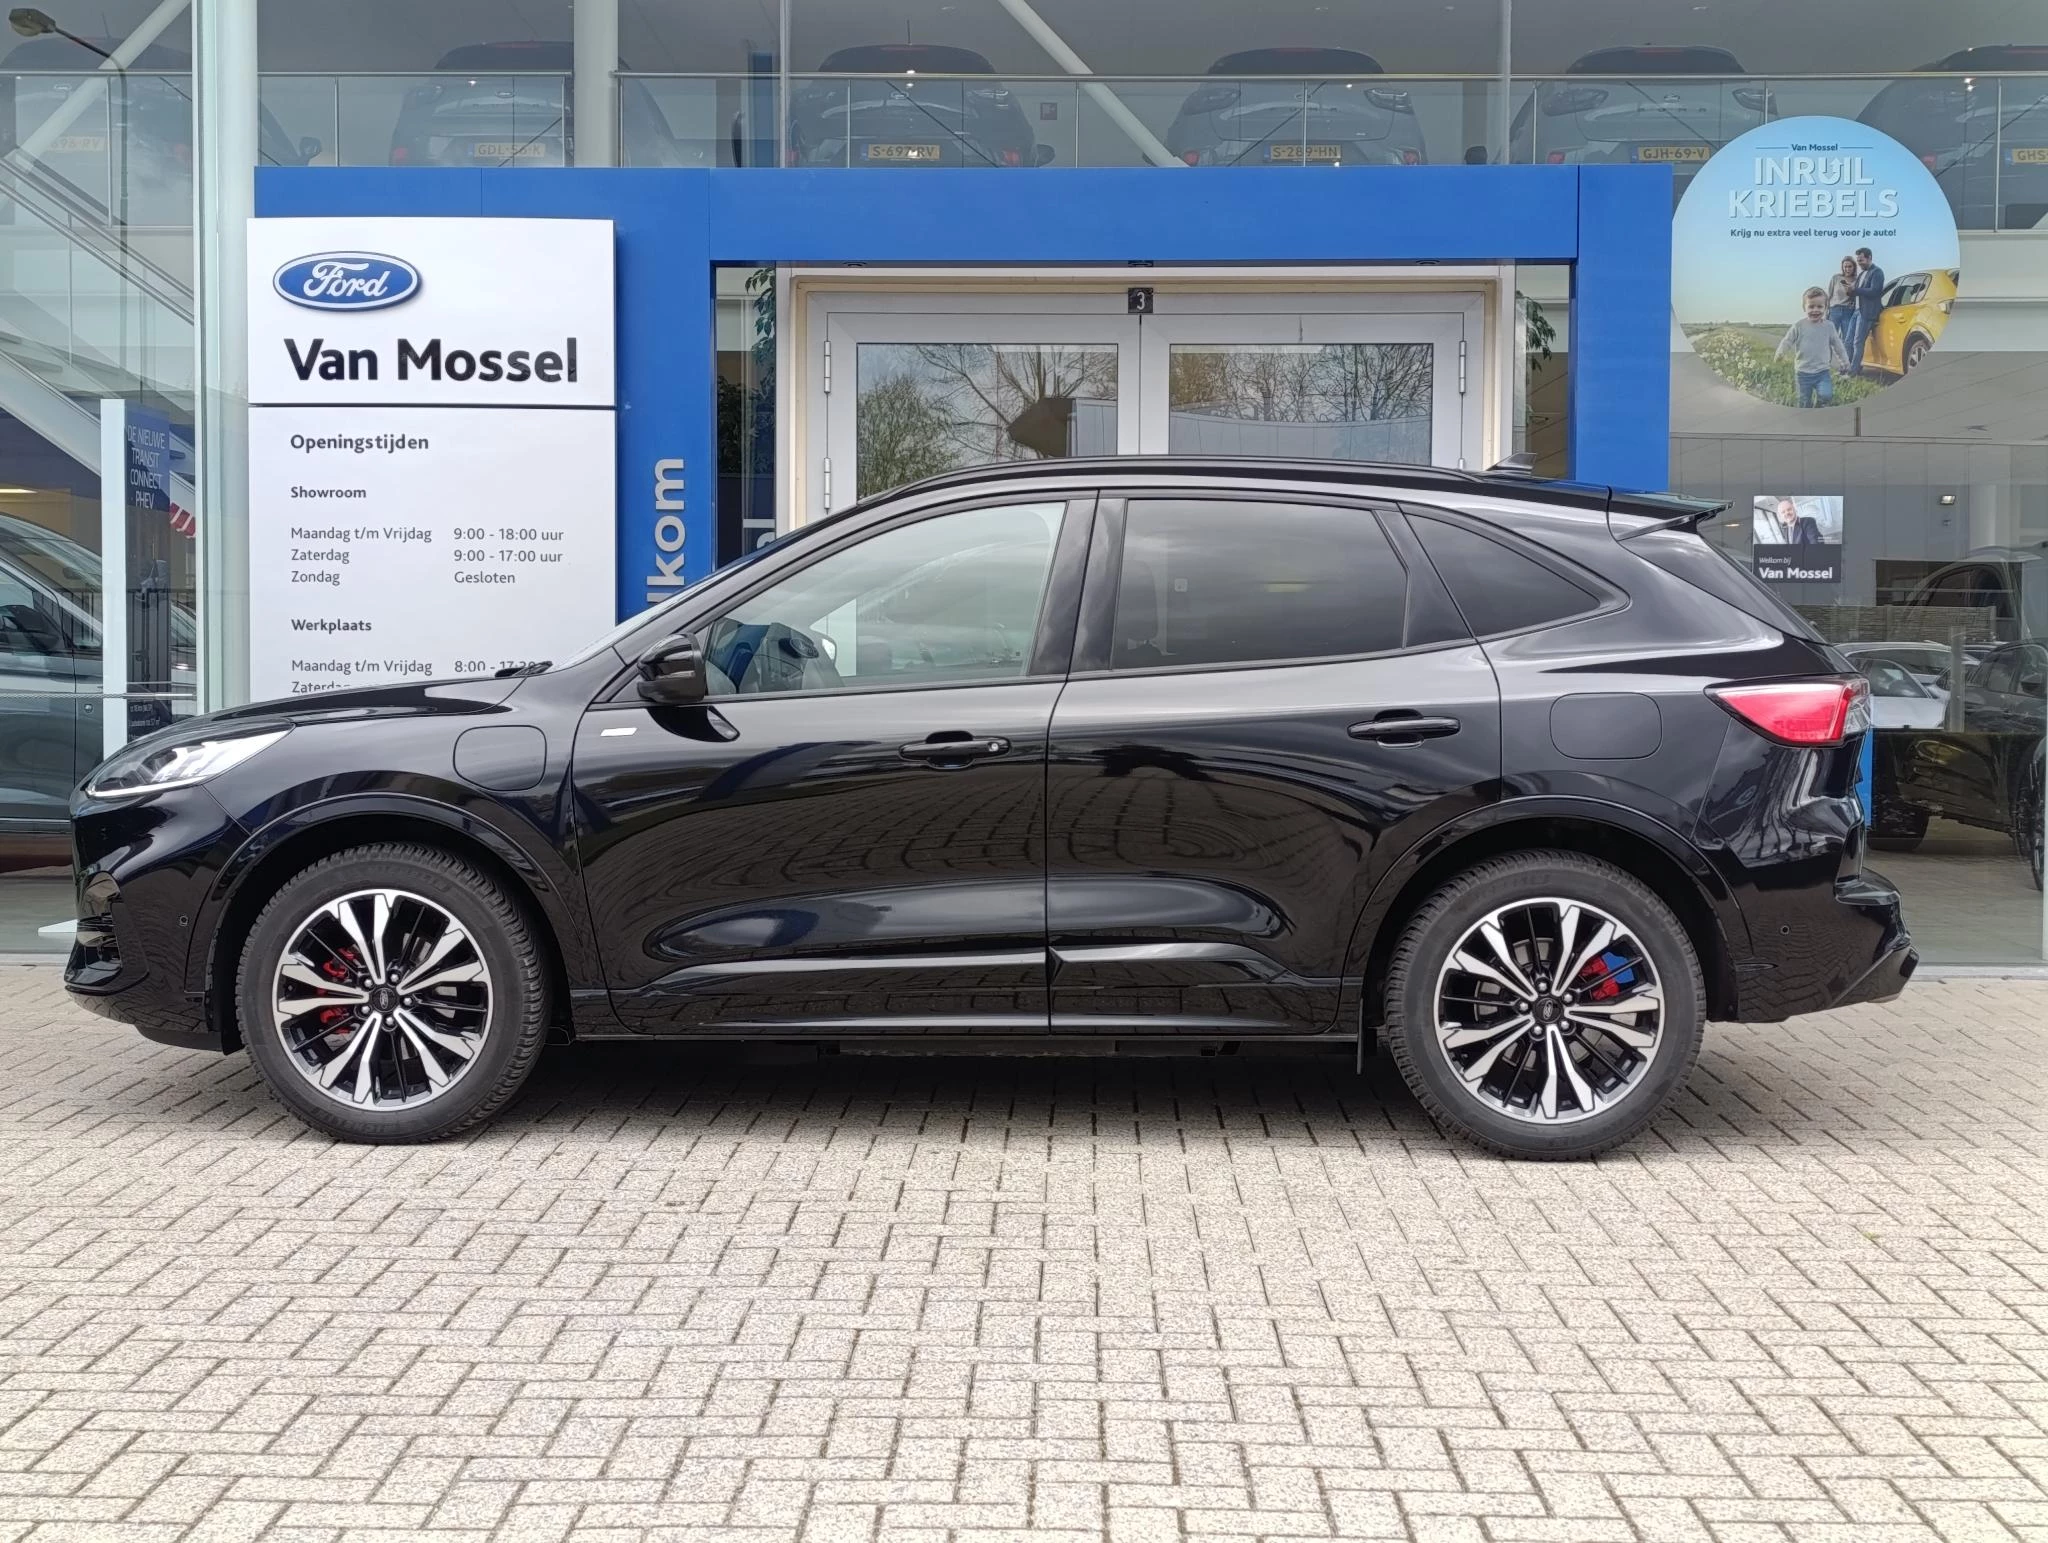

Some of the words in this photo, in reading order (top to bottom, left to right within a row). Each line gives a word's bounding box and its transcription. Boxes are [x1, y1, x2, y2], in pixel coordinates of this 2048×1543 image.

[1272, 147, 1338, 158] S-289-HN
[1643, 149, 1706, 159] GJH-69-V
[1791, 143, 1807, 151] Van
[1809, 143, 1839, 151] Mossel
[1754, 157, 1875, 186] INRUIL
[1728, 189, 1900, 218] KRIEBELS
[1730, 228, 1751, 239] Krijg
[1767, 228, 1790, 237] extra
[1793, 228, 1812, 237] veel
[1814, 229, 1838, 239] terug
[1862, 229, 1872, 239] je
[1873, 228, 1897, 237] auto!
[303, 261, 391, 297] Ford
[1137, 291, 1145, 310] 3
[284, 337, 378, 381] Van
[397, 337, 577, 383] Mossel
[290, 433, 429, 455] Openingstijden
[130, 468, 162, 490] CONNECT
[135, 490, 155, 510] PHEV
[290, 485, 367, 499] Showroom
[290, 526, 351, 544] Maandag
[354, 526, 380, 540] t/m
[382, 526, 432, 544] Vrijdag
[453, 527, 485, 541] 9:00
[499, 527, 538, 541] 18:00
[541, 530, 565, 541] uur
[290, 548, 350, 565] Zaterdag
[453, 549, 486, 563] 9:00
[499, 549, 537, 563] 17:00
[540, 553, 564, 563] uur
[291, 569, 341, 587] Zondag
[454, 570, 516, 584] Gesloten
[1759, 567, 1784, 579] Van
[1787, 567, 1833, 579] Mossel
[290, 618, 372, 635] Werkplaats
[291, 658, 351, 676] Maandag
[354, 659, 380, 673] t/m
[383, 659, 433, 677] Vrijdag
[454, 660, 486, 673] 8:00
[291, 680, 351, 693] Zaterd
